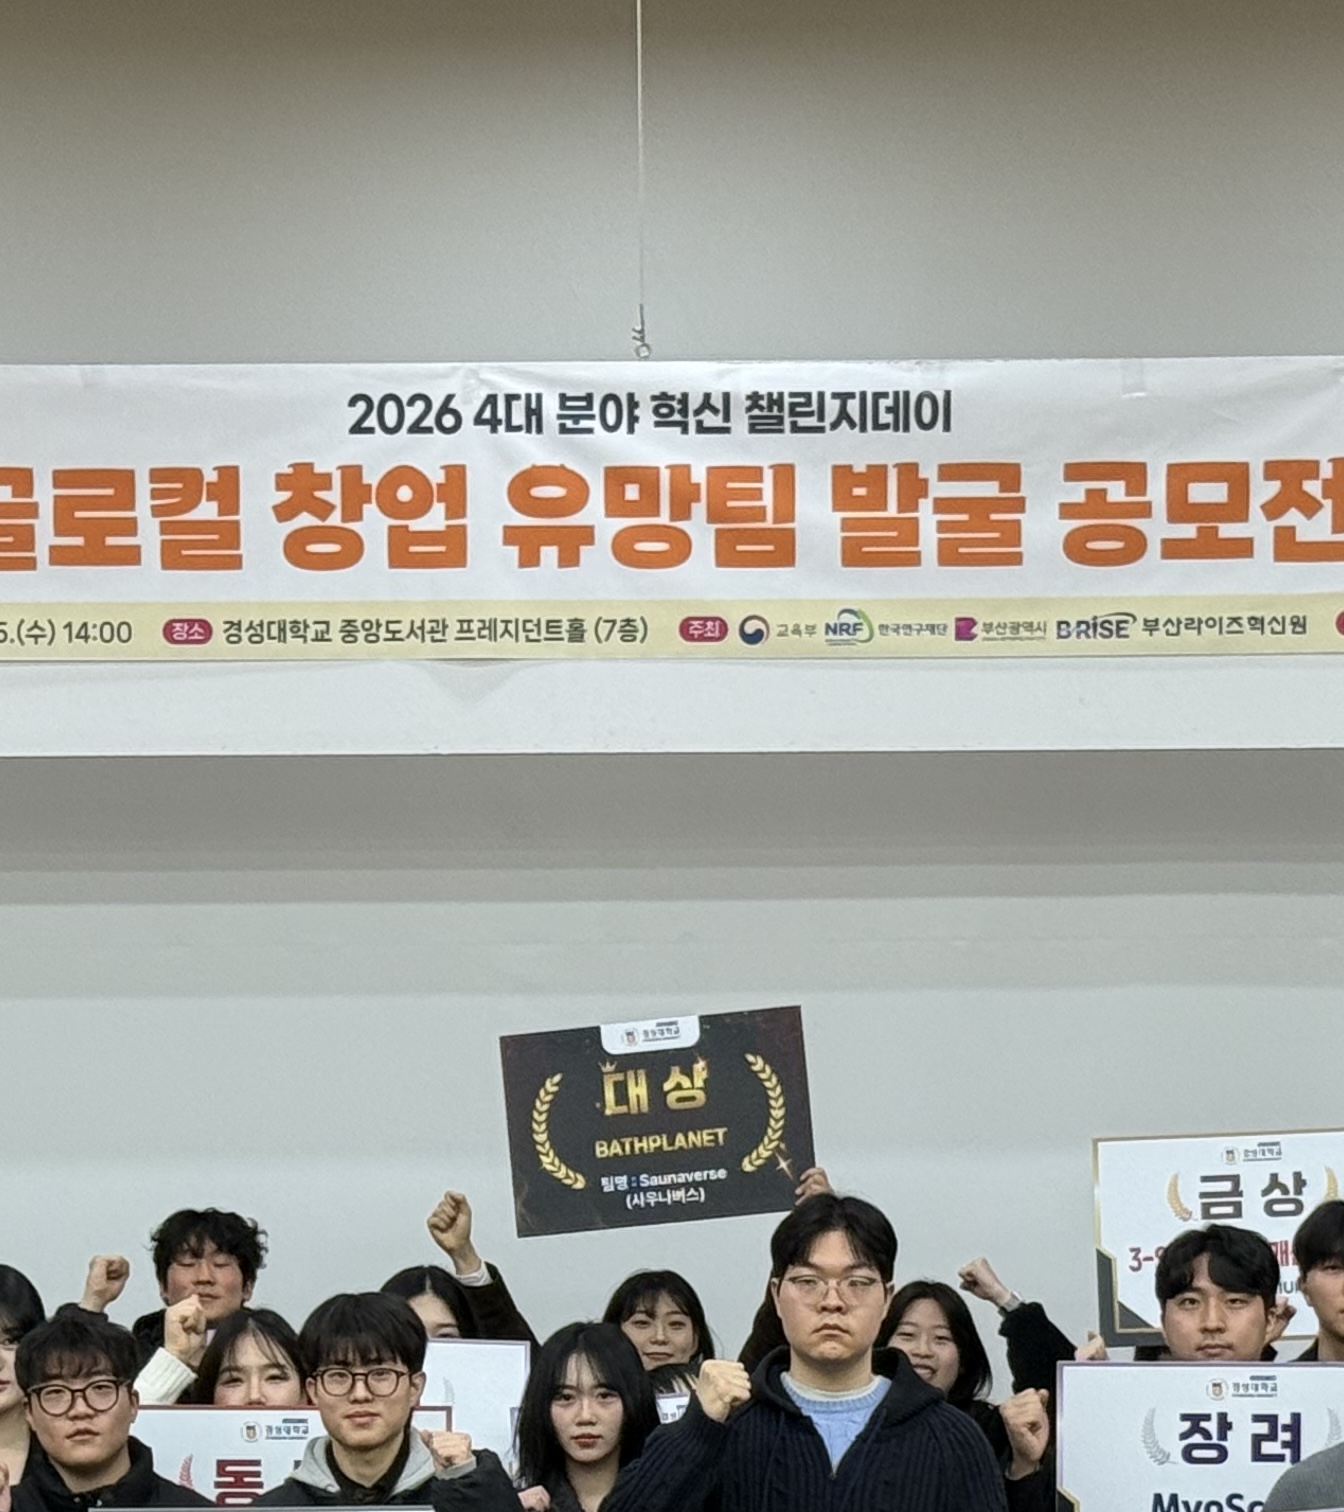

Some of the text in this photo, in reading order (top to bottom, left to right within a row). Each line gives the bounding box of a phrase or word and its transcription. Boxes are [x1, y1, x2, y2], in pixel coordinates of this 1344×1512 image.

[348, 390, 953, 436] 2026 4대 분야 혁신 챌린지데이
[272, 462, 468, 571] 창업
[503, 461, 796, 571] 유망팀
[831, 459, 1027, 568] 발굴
[63, 621, 133, 644] 14:00
[170, 616, 648, 644] 장소 경성대학교 중앙도서관 프레지던트홀 (7층)
[688, 621, 817, 638] 주최 교육부
[825, 623, 863, 636] NRF
[878, 624, 947, 636] 한국연구재단
[982, 621, 1047, 635] 부산광역시
[1142, 615, 1307, 636] 부산라이즈혁신원
[595, 1127, 728, 1159] BATHPLANET
[639, 1167, 728, 1189] Saunaverse
